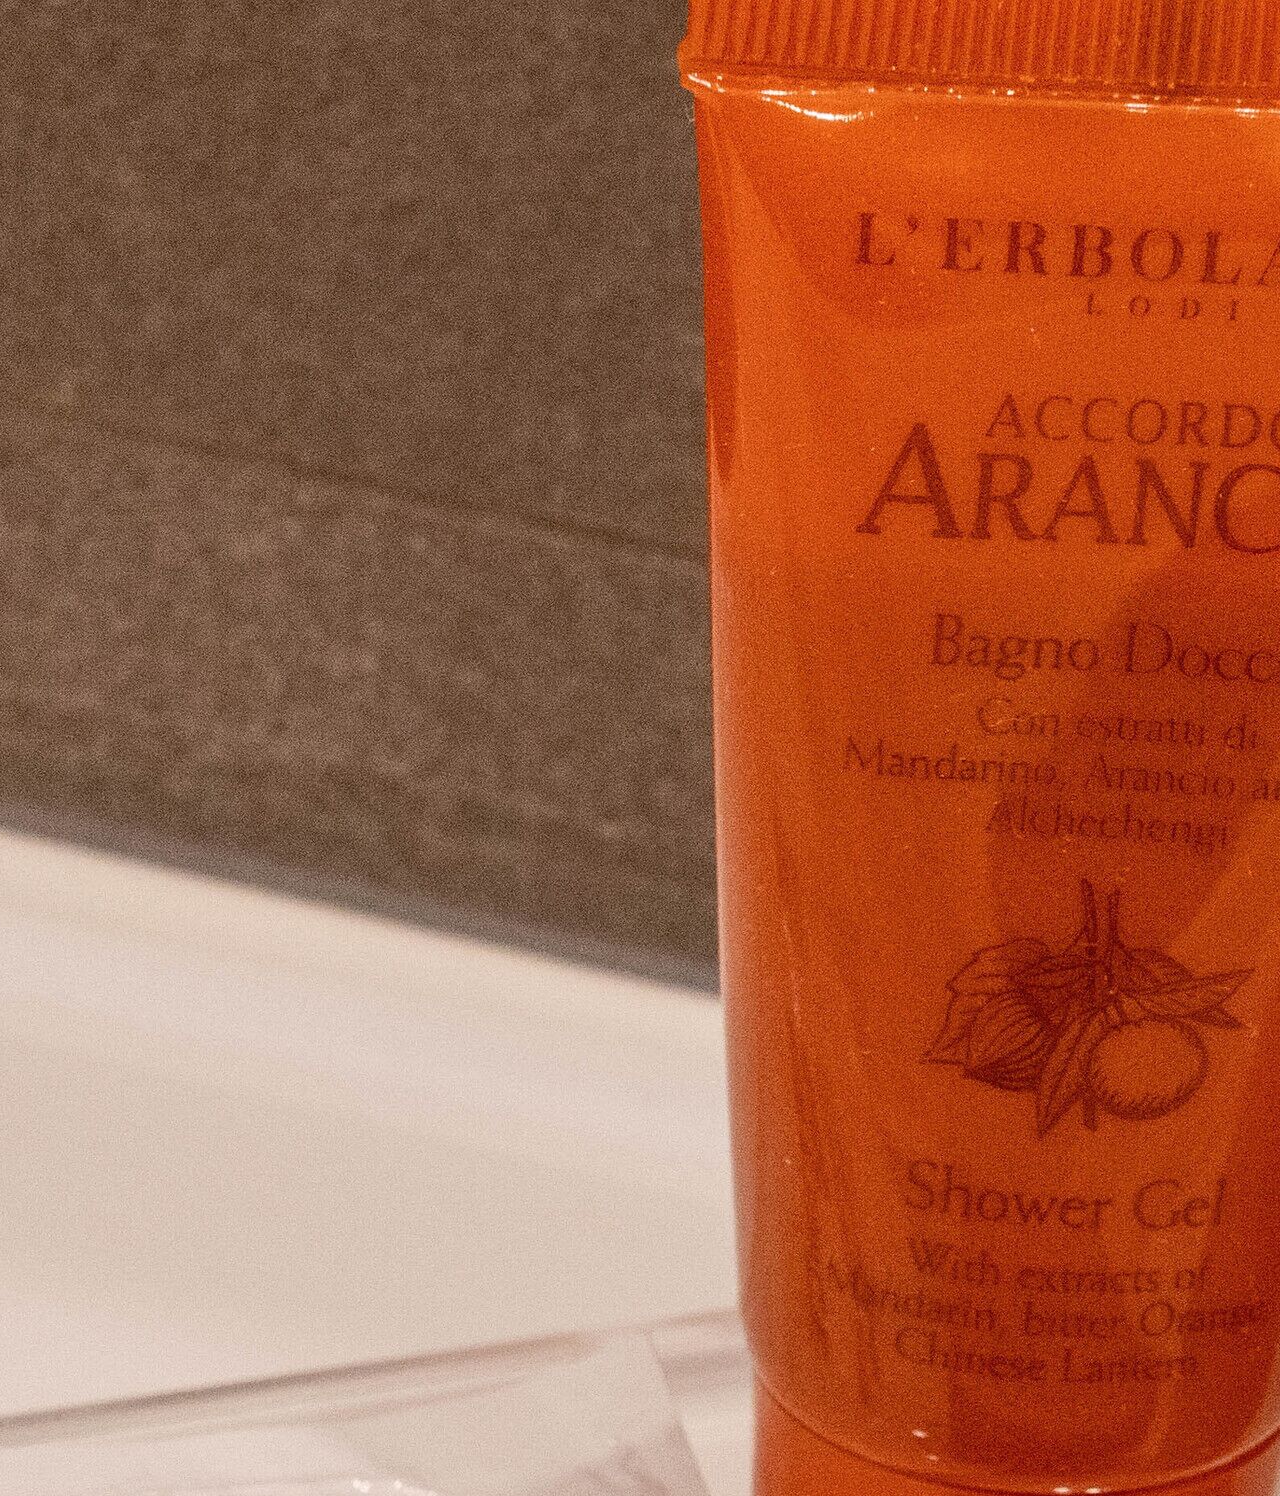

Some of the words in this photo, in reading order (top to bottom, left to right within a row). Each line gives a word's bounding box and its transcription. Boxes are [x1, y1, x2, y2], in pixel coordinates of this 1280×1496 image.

[1086, 294, 1240, 321] LODI
[929, 612, 1099, 681] Bagno
[975, 695, 1061, 737] Con
[1076, 714, 1206, 748] estratti
[1220, 714, 1258, 753] di
[1082, 753, 1236, 799] Arancio
[905, 1158, 1113, 1229] Shower
[1132, 1175, 1226, 1231] Gel
[907, 1238, 1001, 1289] With
[1016, 1257, 1160, 1294] extracts
[1173, 1253, 1211, 1290] of
[894, 1327, 1046, 1382] Chinese
